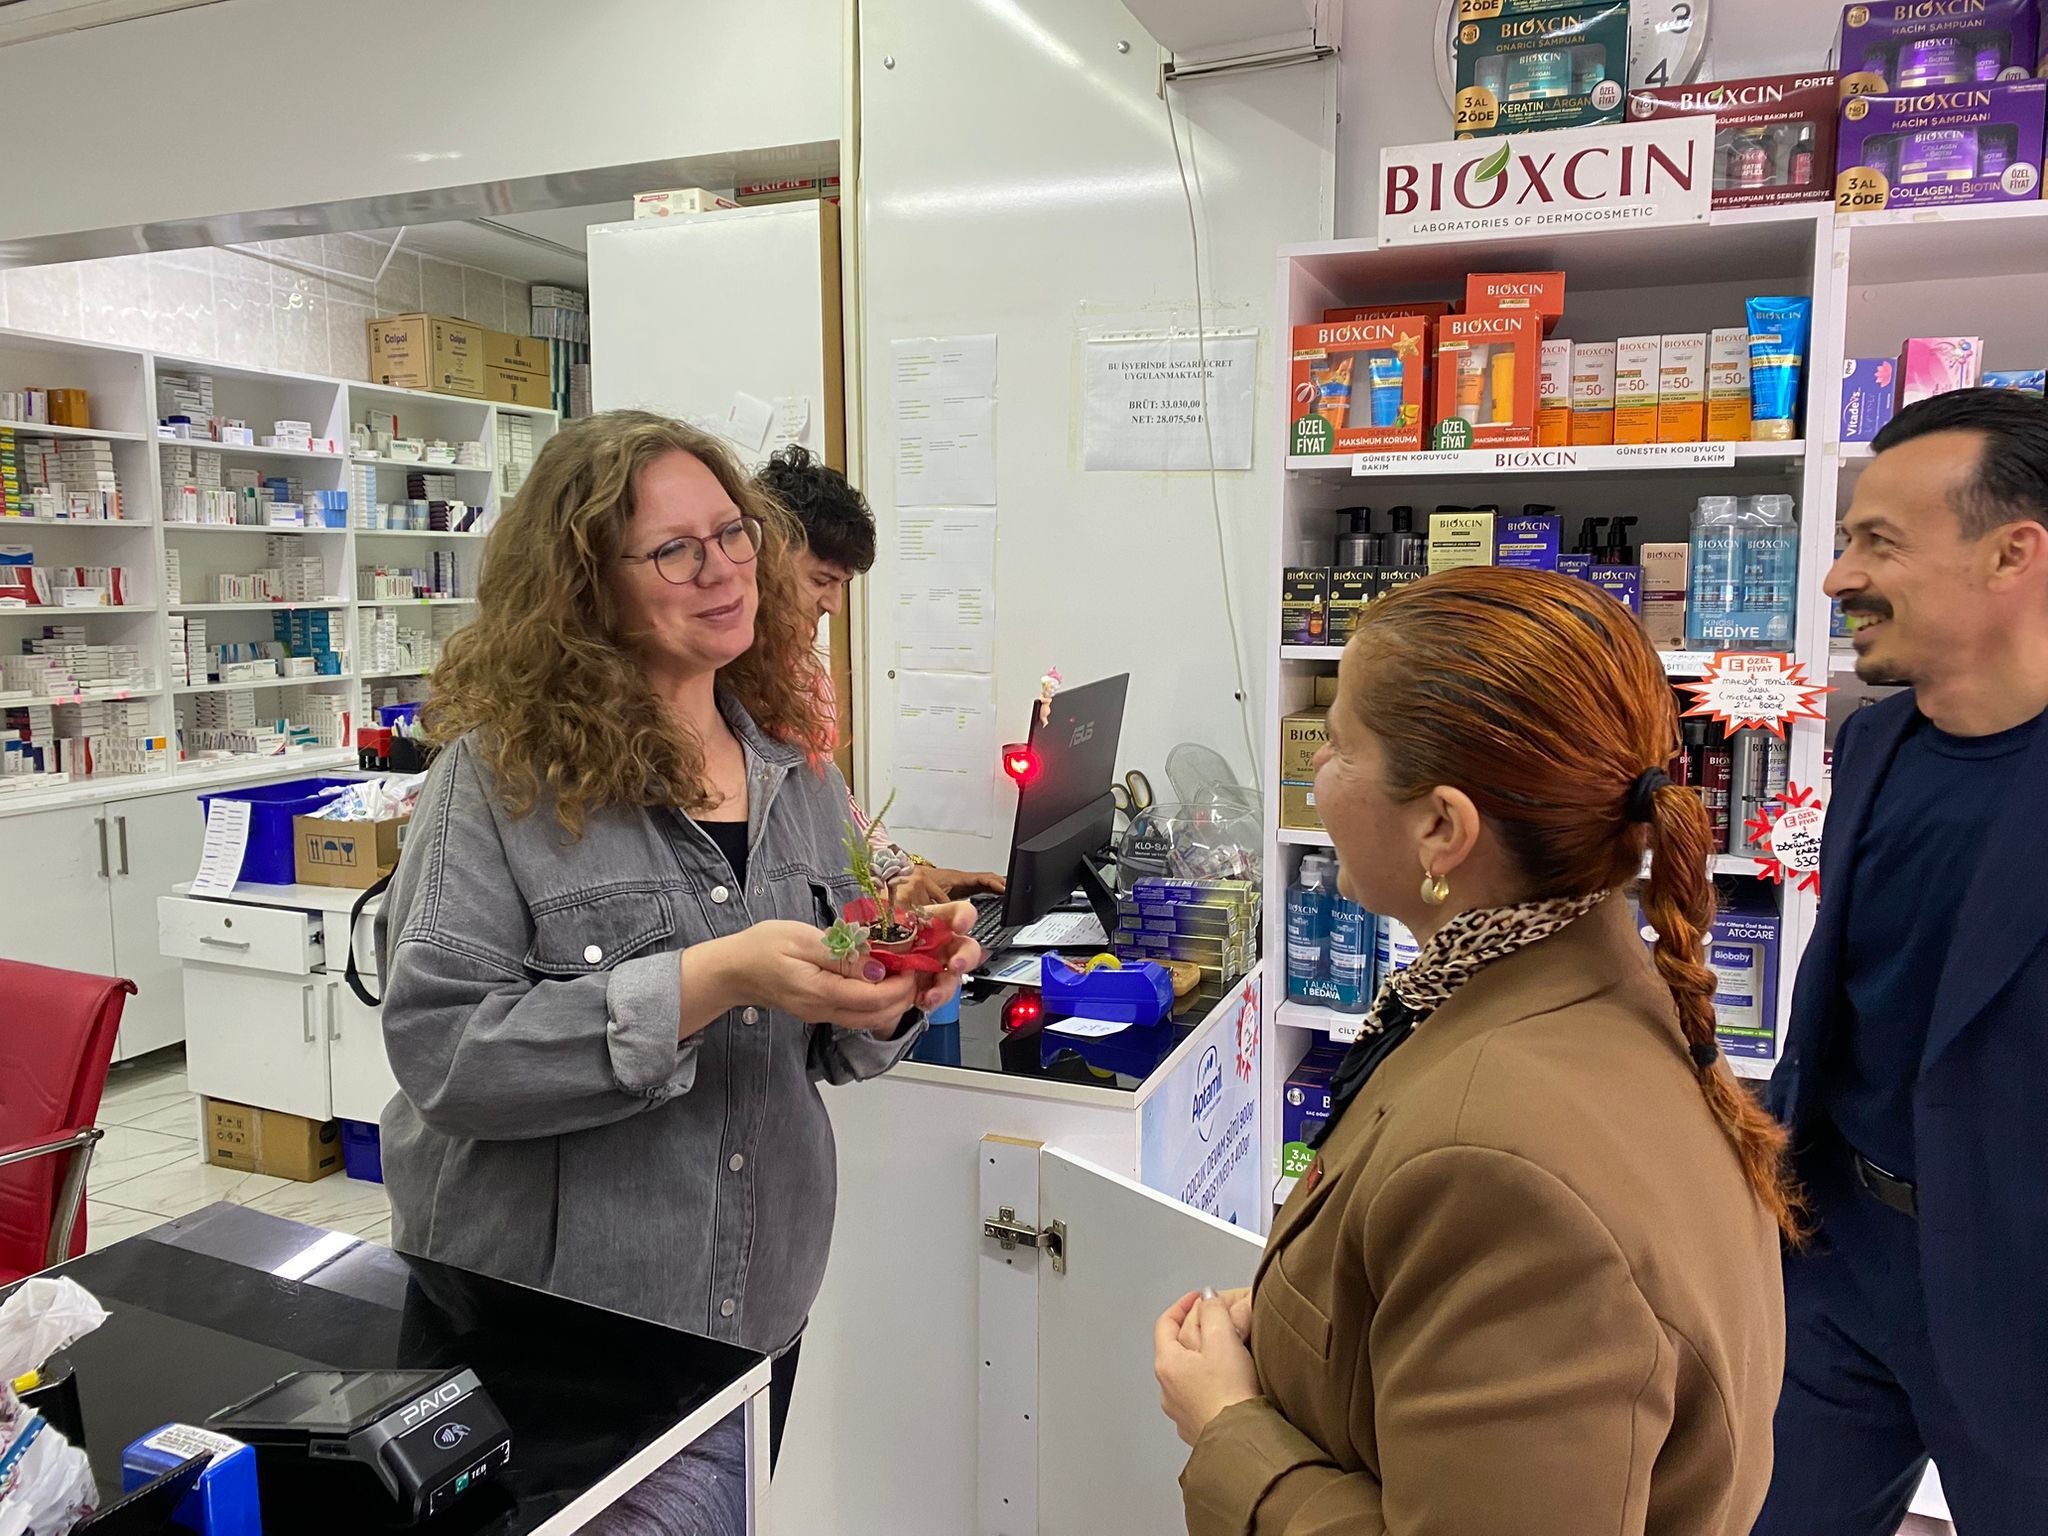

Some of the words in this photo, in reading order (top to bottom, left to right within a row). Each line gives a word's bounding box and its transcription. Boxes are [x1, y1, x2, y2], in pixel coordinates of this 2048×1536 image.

[1462, 0, 1472, 12] 2
[1894, 0, 1985, 21] BIOXCIN
[1501, 14, 1582, 39] BIOXCIN
[1892, 24, 1926, 35] HACİM
[1496, 39, 1536, 52] ONARICI
[1538, 35, 1586, 48] ŞAMPUAN
[1519, 52, 1562, 65] BIOXCIN
[1645, 57, 1670, 87] 4
[1794, 77, 1835, 89] FORTE
[1862, 84, 1877, 93] AL
[1599, 85, 1615, 95] ÖZEL
[1598, 95, 1615, 105] FİYAT
[1680, 85, 1783, 110] BIOXCIN
[1894, 90, 1992, 114] BIOXCIN
[1499, 101, 1544, 115] KERATIN
[1552, 96, 1592, 108] ARGAN
[1457, 111, 1467, 124] 2
[1469, 108, 1494, 121] ÖDE
[1764, 112, 1788, 121] BAKIM
[1789, 111, 1804, 119] KİTİ
[1891, 118, 1928, 129] HACİM
[1931, 112, 1991, 127] ŞAMPUANI
[1914, 130, 1966, 143] BIOXCIN
[1385, 139, 1695, 216] BIOXCIN
[2011, 168, 2030, 179] ÖZEL
[1848, 178, 1858, 190] 3
[1862, 179, 1877, 189] AL
[1890, 184, 1953, 199] COLLAGEN
[1962, 181, 2001, 193] BIOTIN
[2010, 178, 2031, 190] FİYAT
[1777, 191, 1802, 200] SERUM
[1840, 193, 1852, 206] 2
[1854, 188, 1884, 204] ÖDE
[1413, 217, 1509, 233] LABORATORIES
[1515, 215, 1531, 226] OF
[1537, 207, 1653, 225] DERMOCOSMETIC
[1487, 283, 1544, 296] BIOXCIN
[1452, 317, 1522, 335] BIOXCIN
[384, 332, 408, 345] Calpol
[450, 334, 467, 345] Calpol
[1318, 324, 1395, 344] BIOXCIN
[1619, 341, 1658, 351] BIOXCIN
[1664, 339, 1704, 348] BIOXCIN
[1576, 347, 1614, 357] BIOXCIN
[1121, 360, 1168, 370] İŞYERİNDE
[1169, 360, 1201, 369] ASGARİ
[1203, 359, 1233, 368] ÜCRET
[1129, 399, 1158, 410] BRÜT:
[1160, 400, 1200, 409] 33.030,00
[1131, 415, 1154, 424] NET:
[1156, 415, 1196, 425] 28.075,50
[1298, 415, 1326, 436] ÖZEL
[1442, 419, 1466, 434] ÖZEL
[1296, 436, 1325, 454] FİYAT
[1339, 436, 1381, 447] MAKSİMUM
[1383, 435, 1418, 444] KORUMA
[1441, 434, 1467, 449] FİYAT
[1616, 446, 1668, 456] GÜNEŞTEN
[1670, 445, 1725, 454] KORUYUCU
[1362, 454, 1408, 463] GÜNEŞTEN
[1410, 452, 1459, 462] KORUYUCU
[1495, 452, 1577, 467] BIOXCIN
[1693, 454, 1725, 463] BAKIM
[1440, 518, 1482, 528] BIOXCIN
[1507, 521, 1550, 531] BIOXCIN
[1646, 551, 1684, 560] BIOXCIN
[1287, 571, 1326, 580] BIOXCIN
[1333, 571, 1373, 580] BIOXCIN
[1380, 570, 1421, 580] BIOXCIN
[1592, 570, 1637, 580] BIOXCIN
[1703, 624, 1760, 638] HEDİYE
[1747, 657, 1771, 665] ÖZEL
[1747, 665, 1773, 673] FİYAT
[1069, 720, 1095, 748] ASUS
[1798, 811, 1817, 820] ÖZEL
[1727, 928, 1774, 940] ATOCARE
[1714, 951, 1750, 963] Biobaby
[1309, 988, 1341, 1001] BEDAVA
[1338, 1026, 1356, 1036] CİLT
[1192, 1063, 1222, 1124] Aptamil
[1207, 1136, 1226, 1176] DEVAM
[1226, 1112, 1239, 1149] SÜTÜ
[1240, 1099, 1255, 1129] 900gr
[1235, 1133, 1250, 1163] 400gr
[400, 1382, 461, 1426] PAVO
